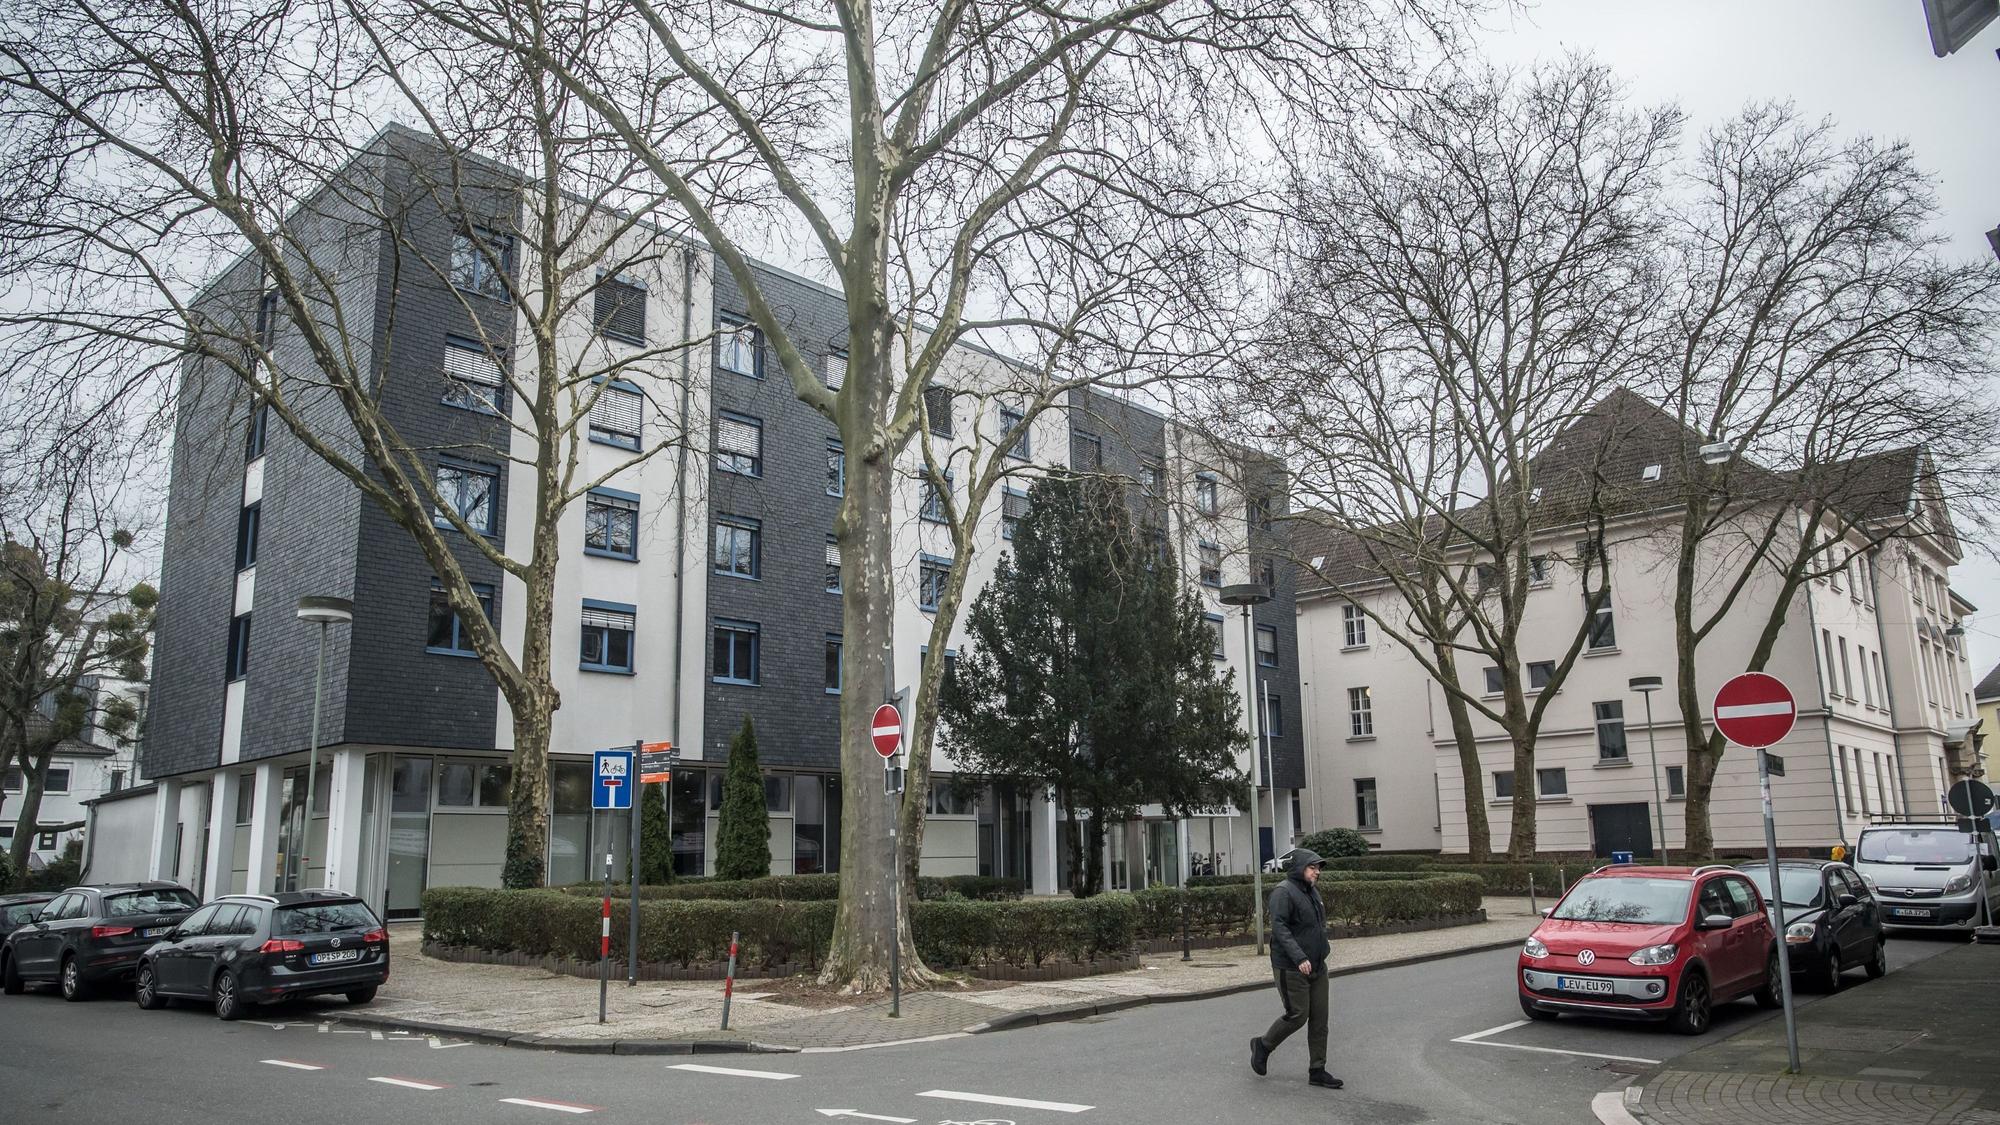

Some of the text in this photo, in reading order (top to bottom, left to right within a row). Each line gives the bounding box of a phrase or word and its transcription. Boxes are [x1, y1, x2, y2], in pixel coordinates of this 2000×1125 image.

[317, 953, 326, 961] OP
[342, 950, 356, 958] 208
[1563, 980, 1612, 992] LEV EU 99
